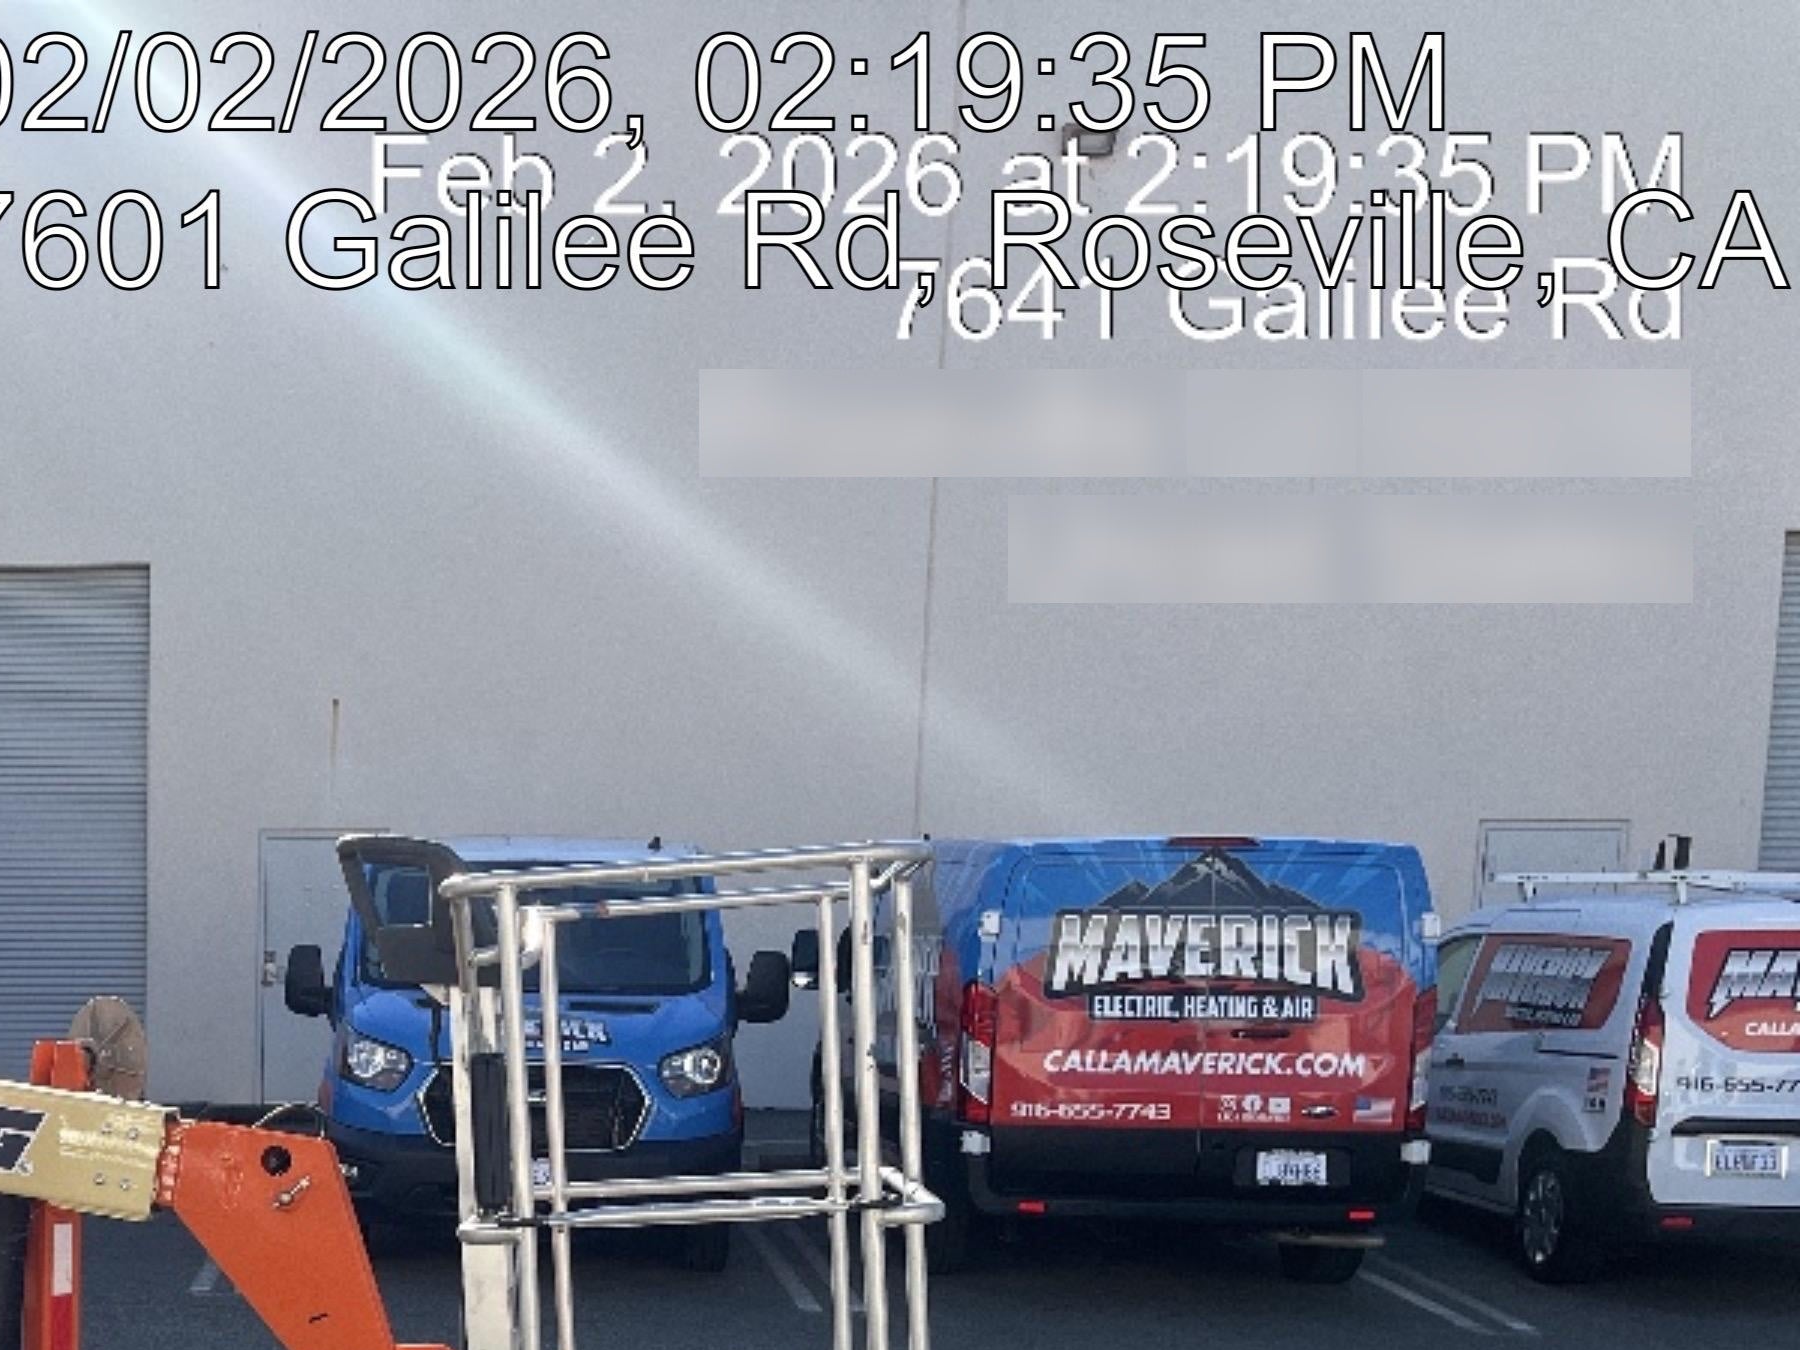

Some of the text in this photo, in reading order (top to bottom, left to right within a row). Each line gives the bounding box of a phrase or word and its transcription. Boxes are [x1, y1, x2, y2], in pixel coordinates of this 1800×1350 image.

[1052, 913, 1355, 995] MAVERICK
[1093, 995, 1314, 1021] ELECTRIC, HEATING & AIR
[1043, 1049, 1366, 1078] CALLAMAVERICK.COM
[1010, 1102, 1172, 1121] 916-655-7743
